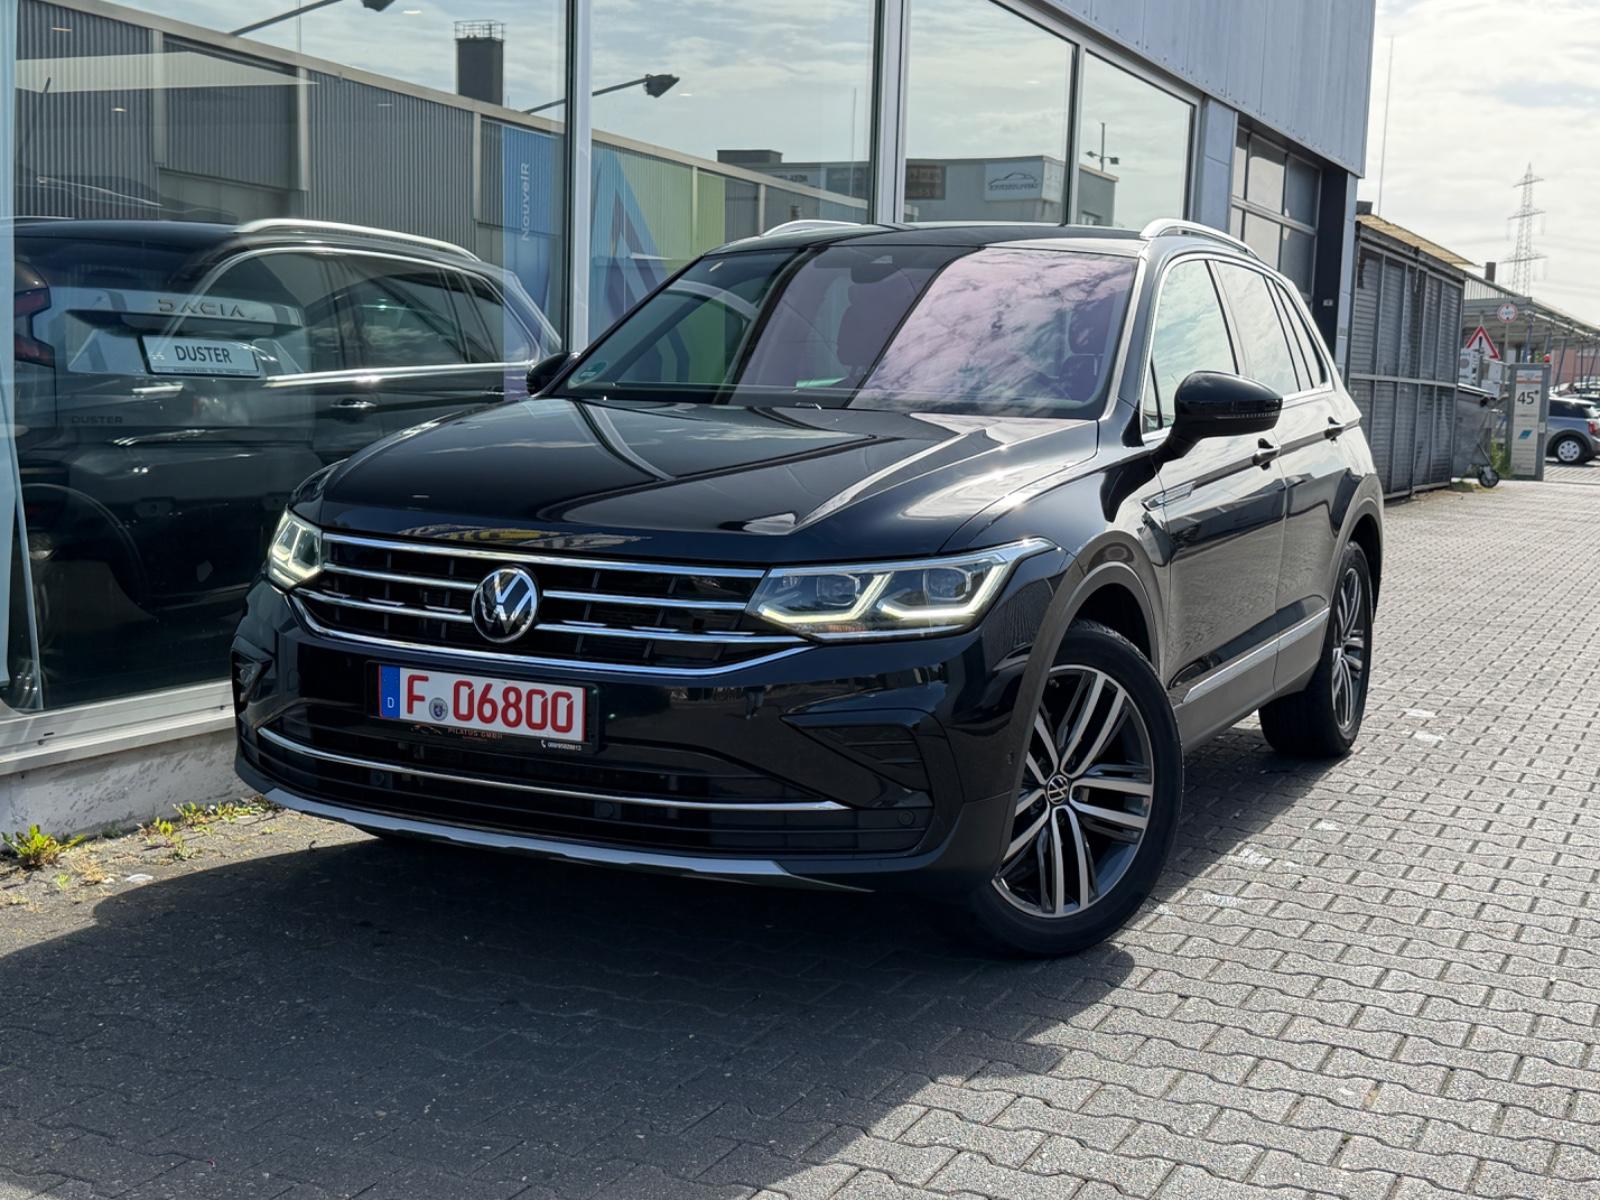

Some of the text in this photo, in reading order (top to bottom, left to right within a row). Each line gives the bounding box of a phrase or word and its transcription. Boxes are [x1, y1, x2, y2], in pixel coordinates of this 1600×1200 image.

[158, 298, 245, 318] DACIA
[174, 345, 233, 364] DUSTER
[71, 415, 123, 424] DUSTER
[387, 697, 395, 709] D
[406, 674, 573, 733] F 06800
